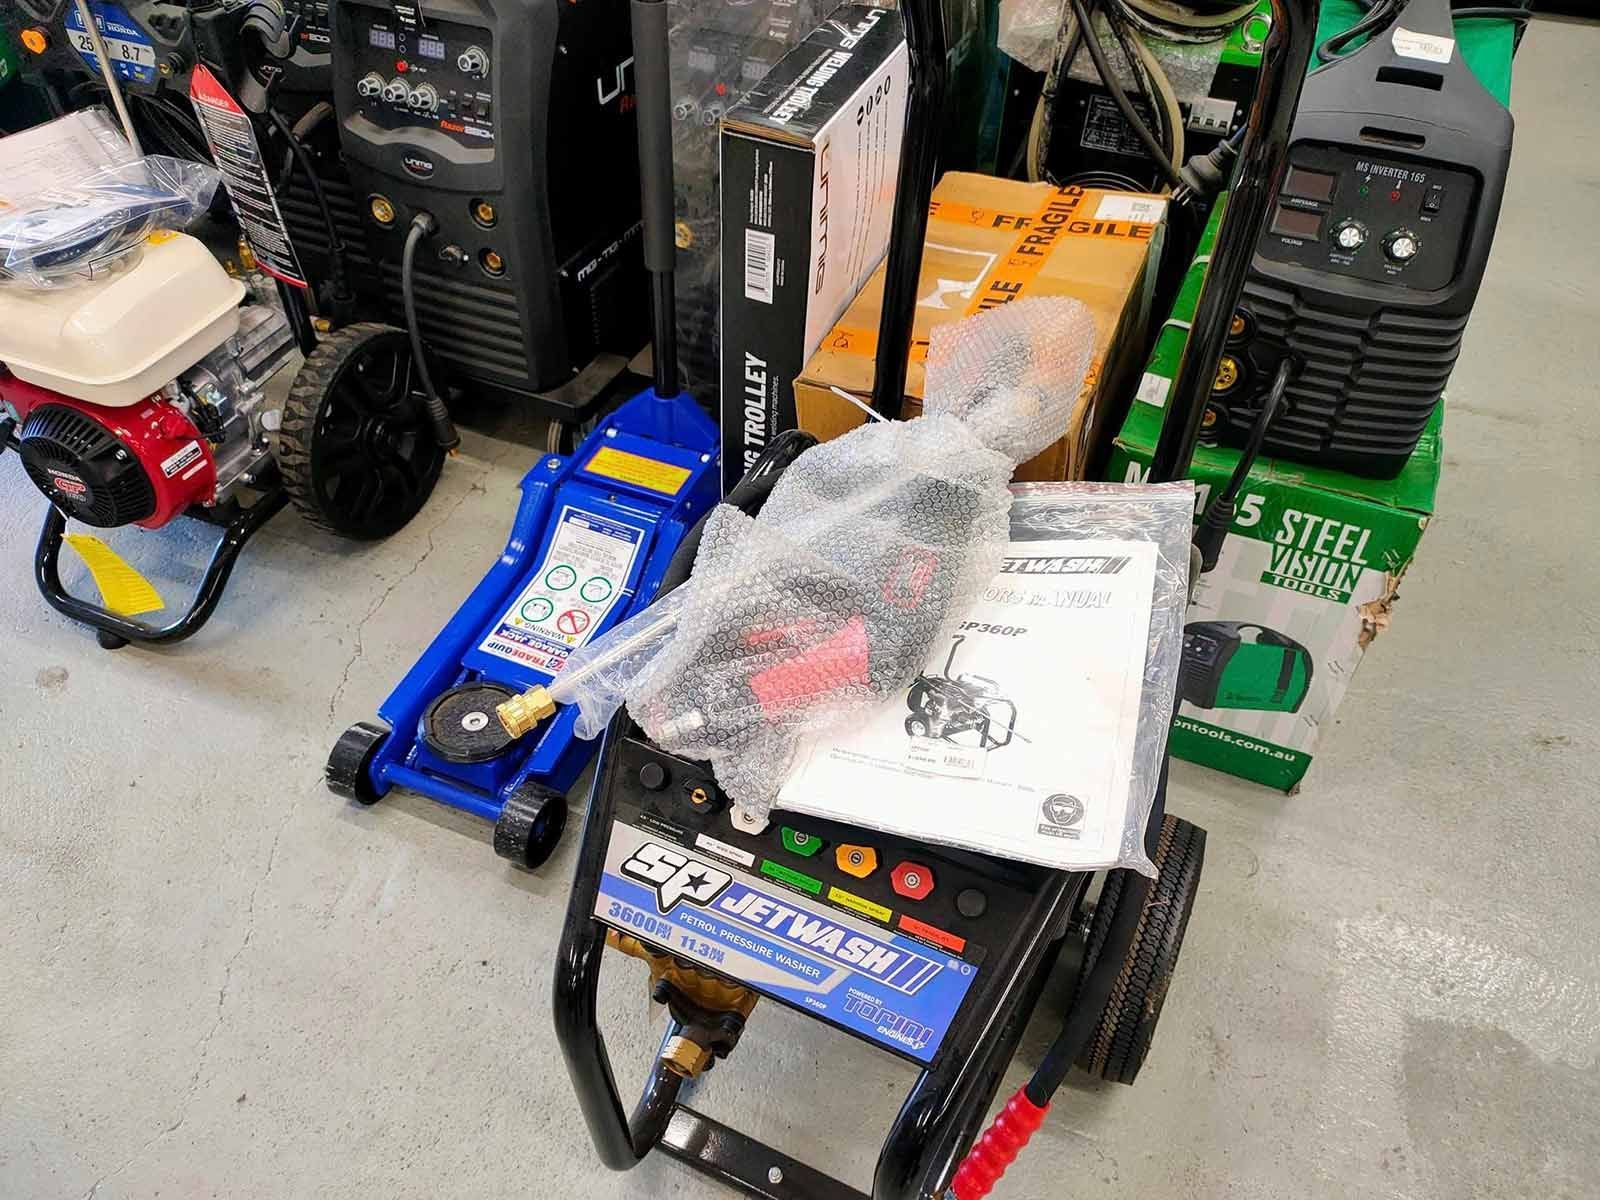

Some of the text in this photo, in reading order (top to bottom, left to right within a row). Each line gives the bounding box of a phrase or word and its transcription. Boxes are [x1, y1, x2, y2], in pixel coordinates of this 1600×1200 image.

[121, 44, 140, 61] 8.7
[806, 50, 854, 88] WELDING
[1355, 161, 1426, 184] MS INVERTER 165
[991, 214, 1153, 240] FRGILE
[1016, 184, 1086, 257] FRAGILE
[744, 351, 767, 447] TROLLEY
[47, 468, 84, 483] HONDA
[1275, 508, 1371, 565] STEEL
[1270, 544, 1364, 593] VISION
[1273, 574, 1341, 601] TOOLS
[500, 629, 528, 644] JACK
[524, 622, 566, 641] WARNING
[487, 641, 547, 668] TRADEQUIP
[527, 640, 569, 659] GARAGE
[621, 841, 899, 976] SP JETWASH
[679, 911, 822, 979] PETROL PRESSURE WASHER
[876, 1024, 914, 1046] ENGINES
